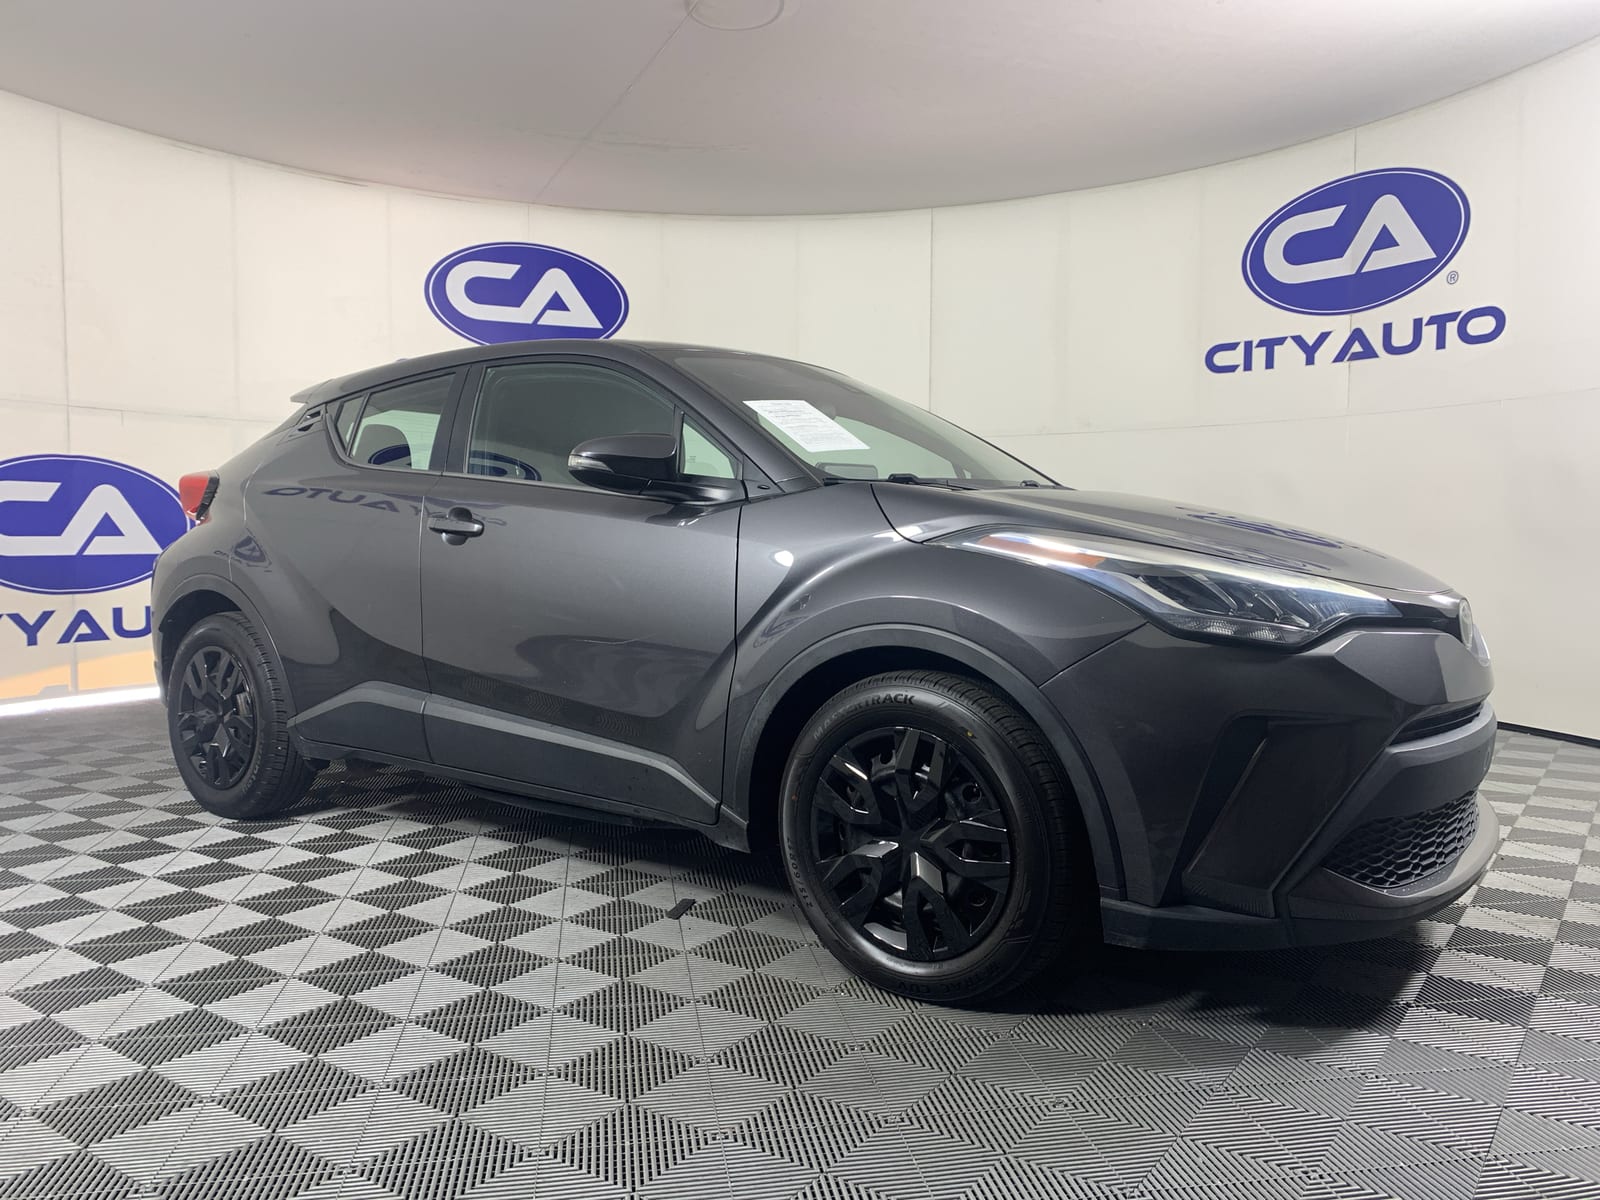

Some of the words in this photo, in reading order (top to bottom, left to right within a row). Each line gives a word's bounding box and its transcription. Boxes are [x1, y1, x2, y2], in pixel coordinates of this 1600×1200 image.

[1263, 193, 1437, 284] CA
[445, 260, 604, 329] CA
[0, 479, 164, 557] CA
